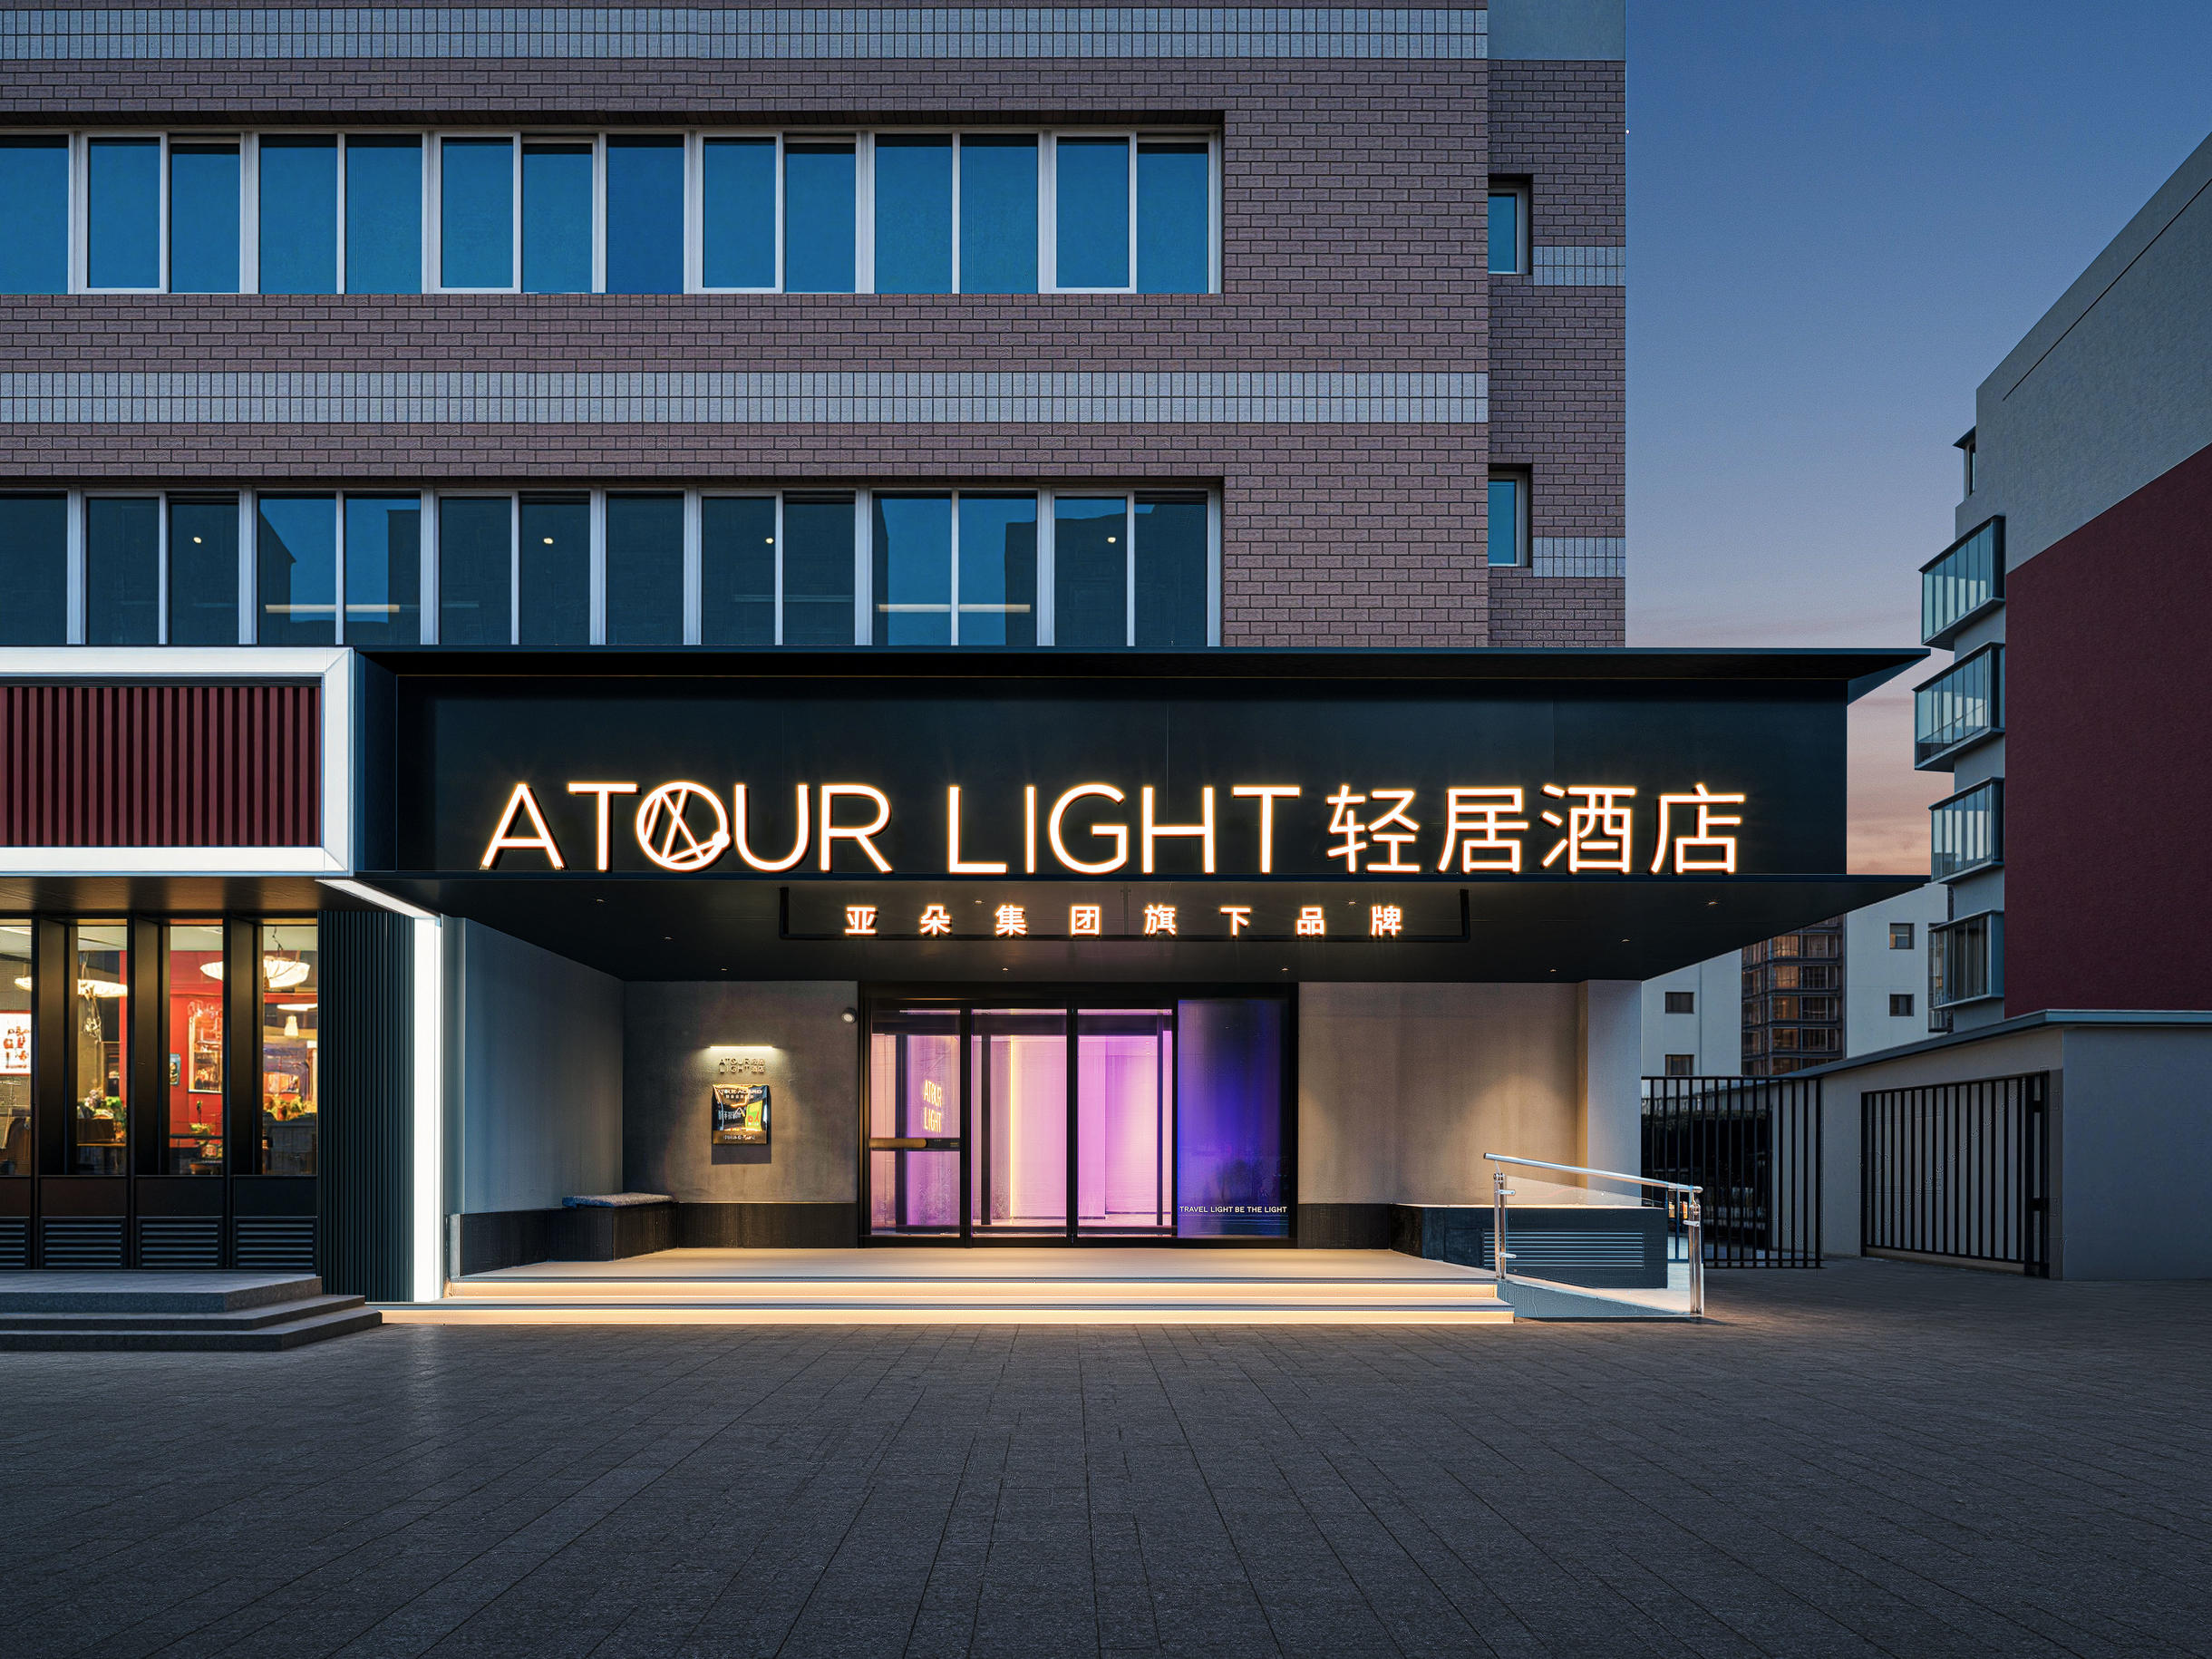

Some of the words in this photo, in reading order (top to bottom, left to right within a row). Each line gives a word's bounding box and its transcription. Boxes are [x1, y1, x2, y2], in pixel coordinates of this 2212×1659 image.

[480, 781, 894, 873] ATOUR
[947, 782, 1301, 874] LIGHT
[1326, 783, 1746, 874] 轻居酒店
[843, 904, 1404, 937] 亚朵集团旗下品牌
[924, 1106, 942, 1133] LIGHT
